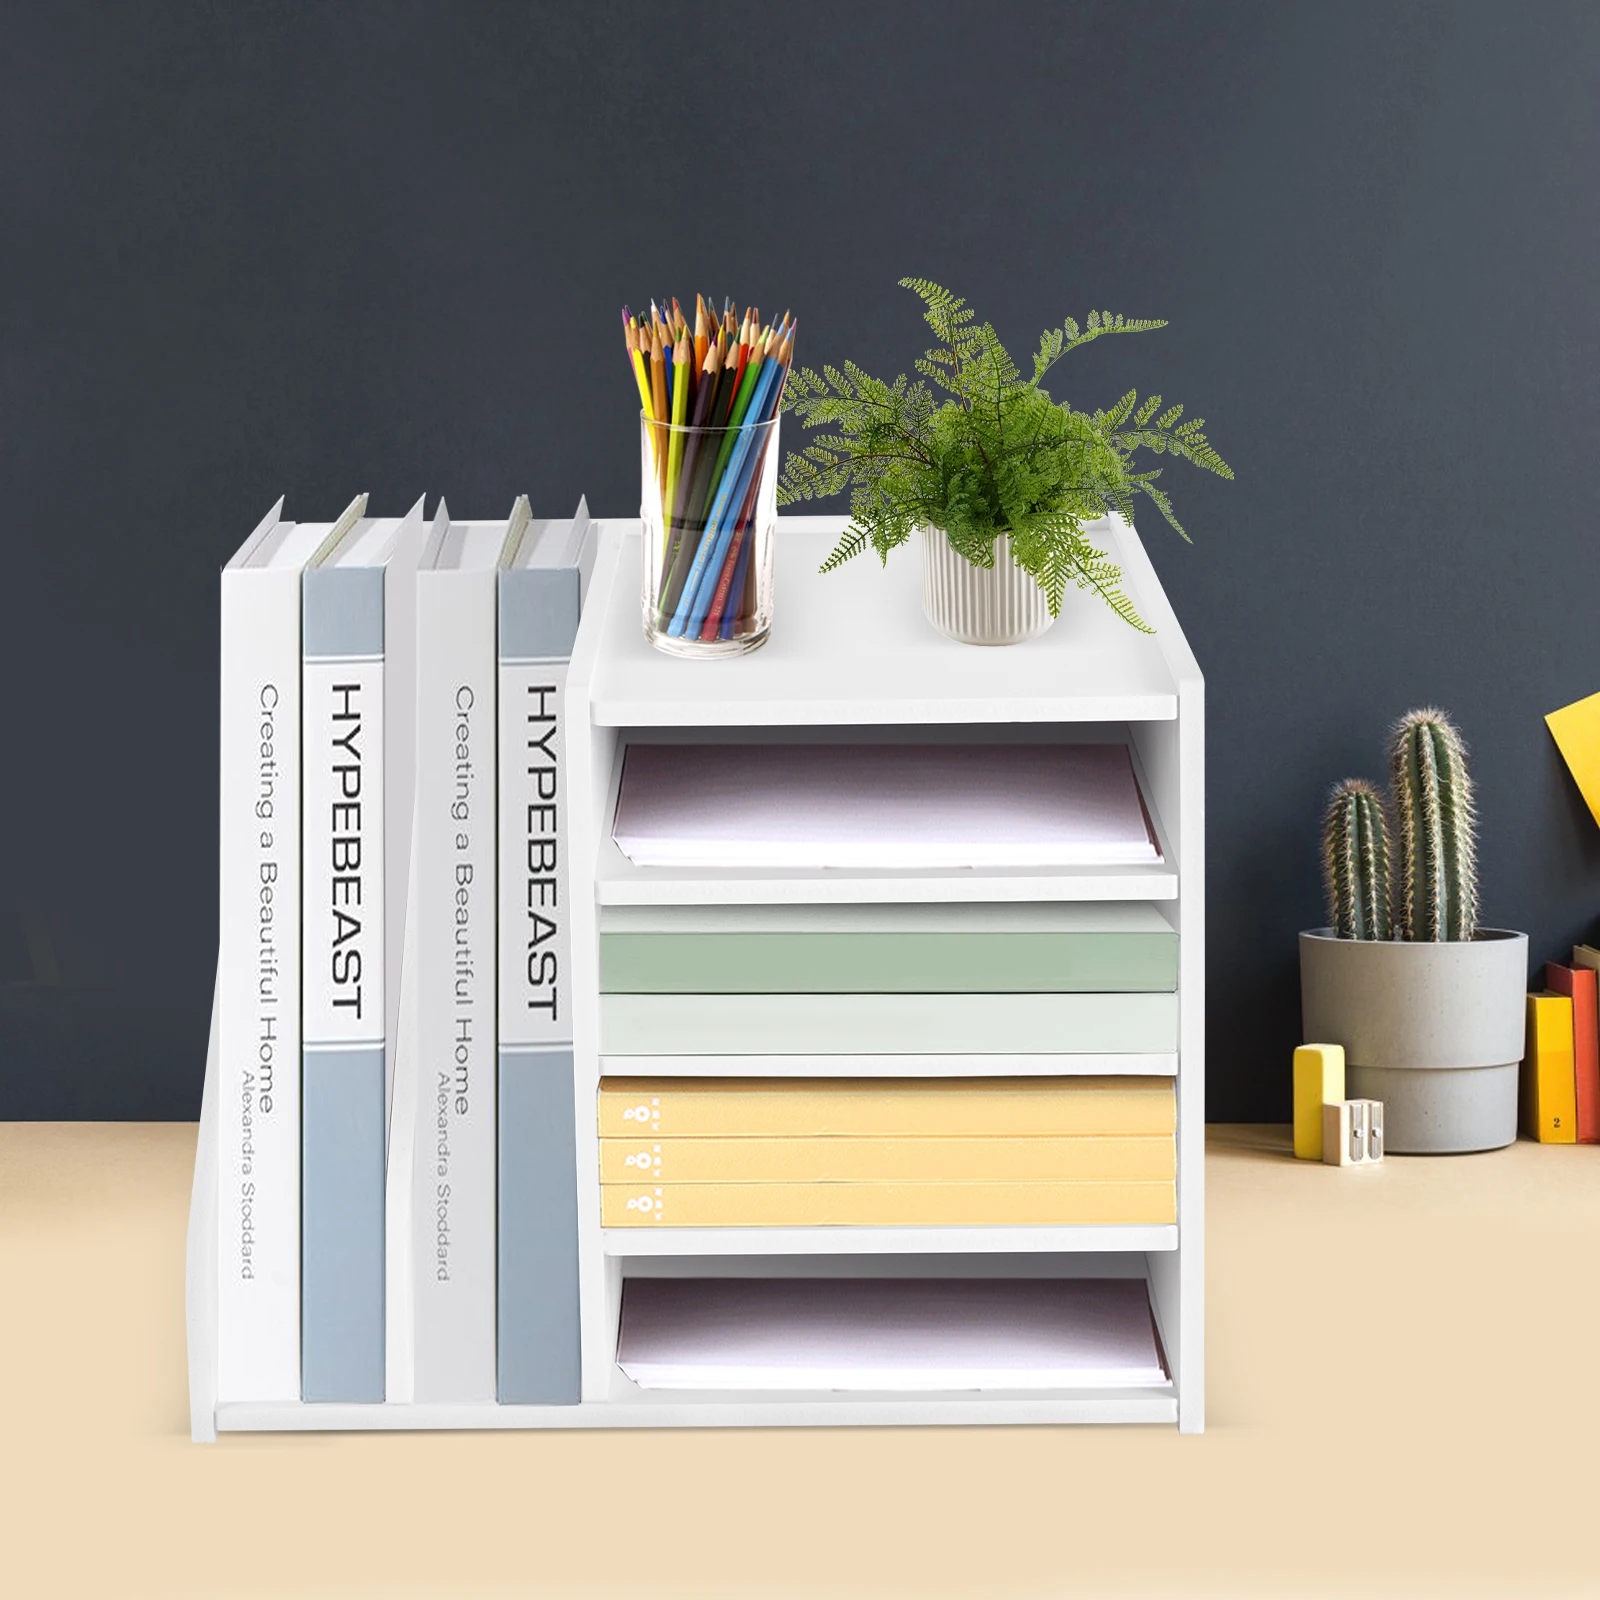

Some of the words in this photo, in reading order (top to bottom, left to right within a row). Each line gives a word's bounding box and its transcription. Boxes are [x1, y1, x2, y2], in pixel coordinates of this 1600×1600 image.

[254, 683, 279, 820] Creating
[450, 685, 475, 821] Creating
[259, 830, 274, 849] a
[331, 683, 362, 1021] HYPEBEAST
[455, 832, 470, 851] a
[527, 685, 558, 1022] HYPEBEAST
[259, 861, 279, 1004] Beautiful
[454, 863, 475, 1006] Beautiful
[258, 1016, 278, 1114] Home
[454, 1018, 473, 1116] Home
[241, 1070, 256, 1176] Alexandra
[436, 1071, 452, 1177] Alexandra
[1553, 1118, 1561, 1128] 2
[241, 1182, 256, 1280] Stoddard
[436, 1183, 452, 1281] Stoddard
